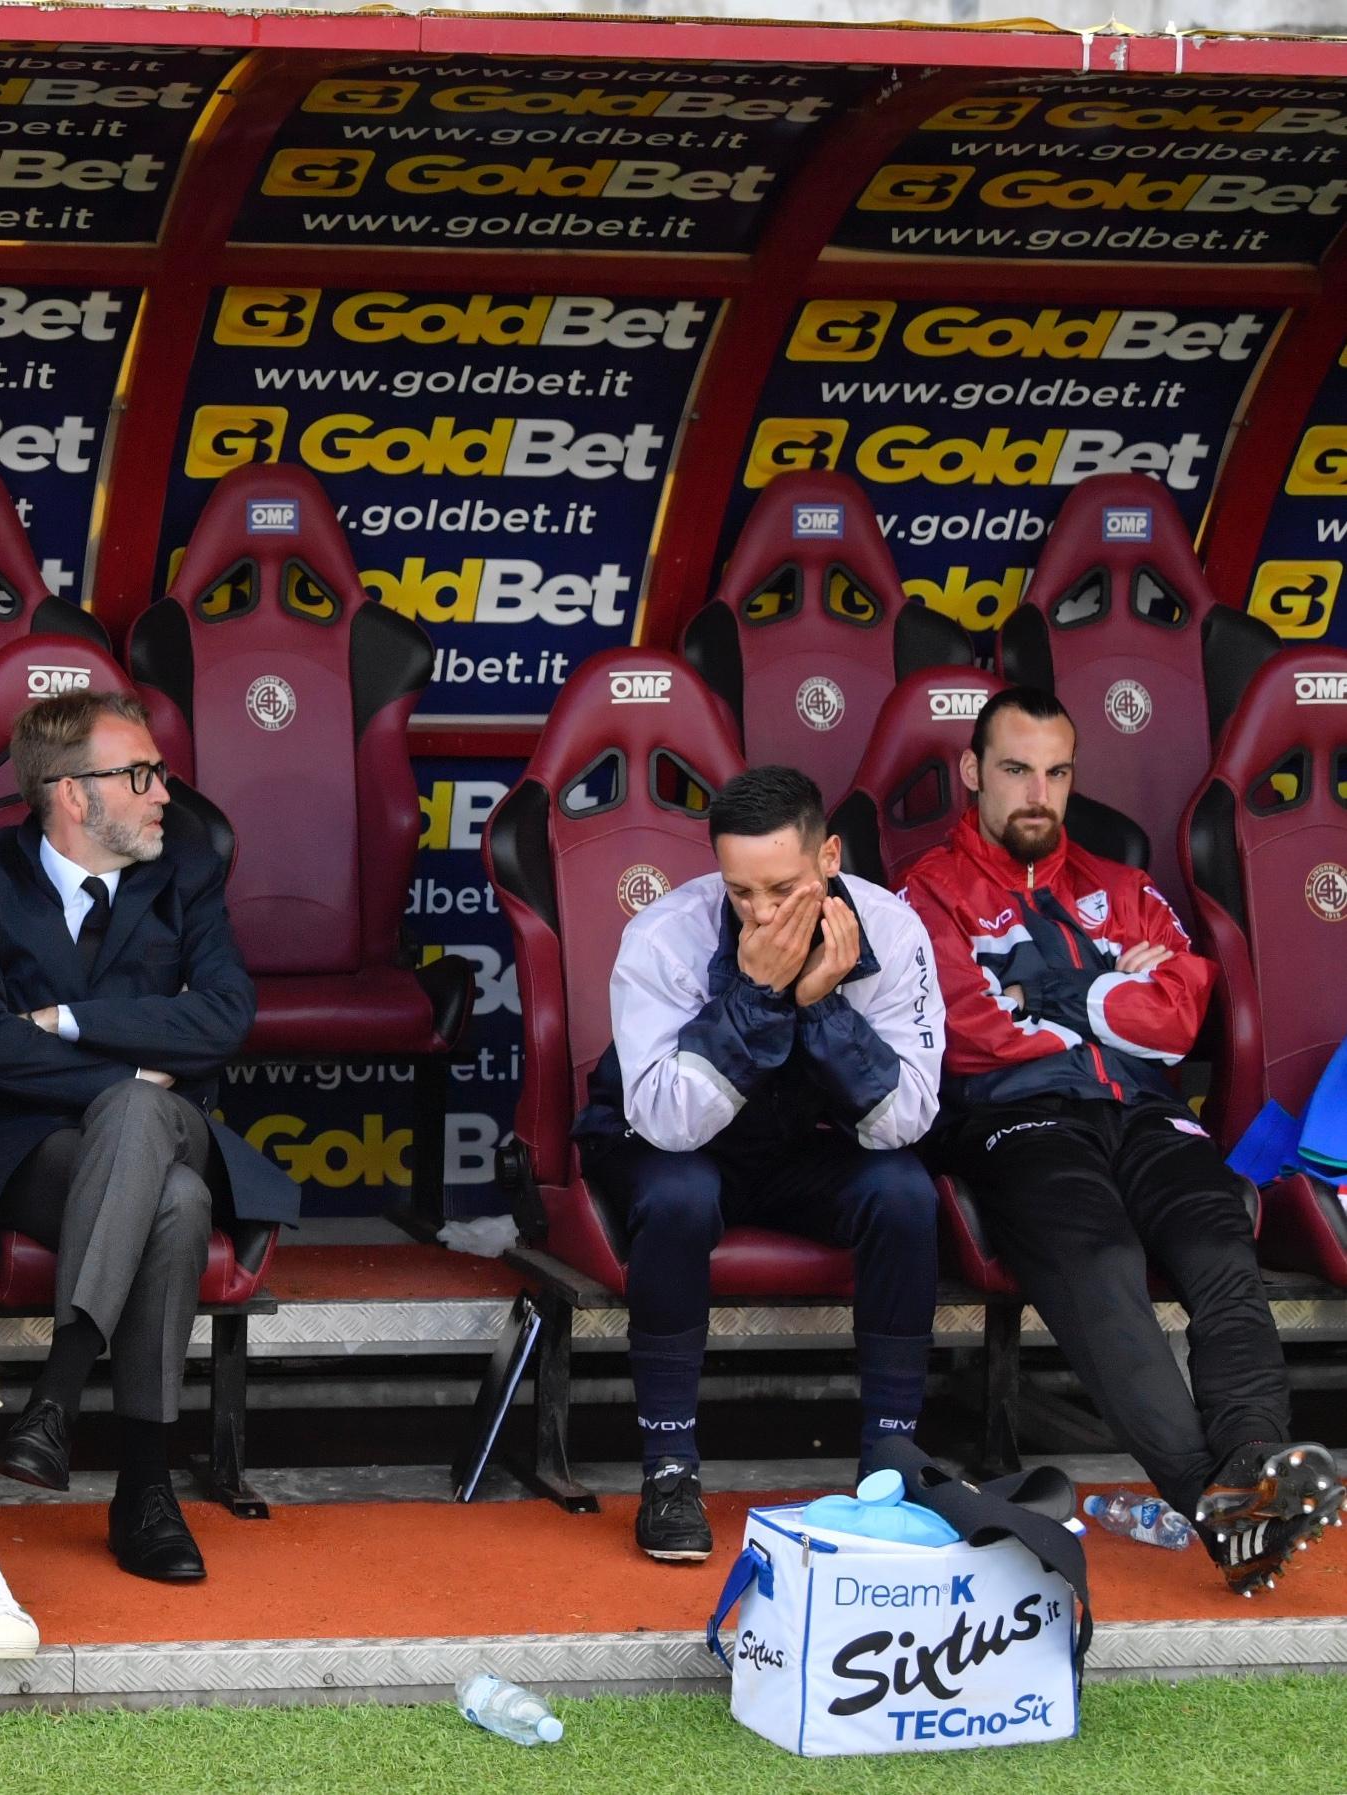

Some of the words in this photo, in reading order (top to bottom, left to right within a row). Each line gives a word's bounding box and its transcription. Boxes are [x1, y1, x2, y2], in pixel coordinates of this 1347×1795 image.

[388, 65, 808, 88] www.goldbet.it
[430, 85, 835, 124] GoldBet
[1017, 84, 1347, 101] www.goldbe
[342, 125, 748, 149] www.goldbet.it
[950, 142, 1341, 164] www.goldbet.it
[385, 155, 776, 203] GoldBet
[979, 170, 1347, 216] GoldBet
[302, 211, 697, 239] www.goldbet.it
[890, 224, 1270, 250] www.goldbet.it
[332, 292, 705, 350] GoldBet
[903, 307, 1263, 361] GoldBet
[254, 365, 632, 398] www.goldbet.it
[820, 378, 1186, 409] www.goldbet.it
[300, 413, 663, 480] GoldBet
[855, 425, 1209, 490] GoldBet
[251, 506, 294, 526] OMP
[796, 512, 838, 531] OMP
[1106, 514, 1147, 534] OMP
[28, 671, 90, 693] OMP
[610, 676, 671, 698] OMP
[928, 694, 987, 715] OMP
